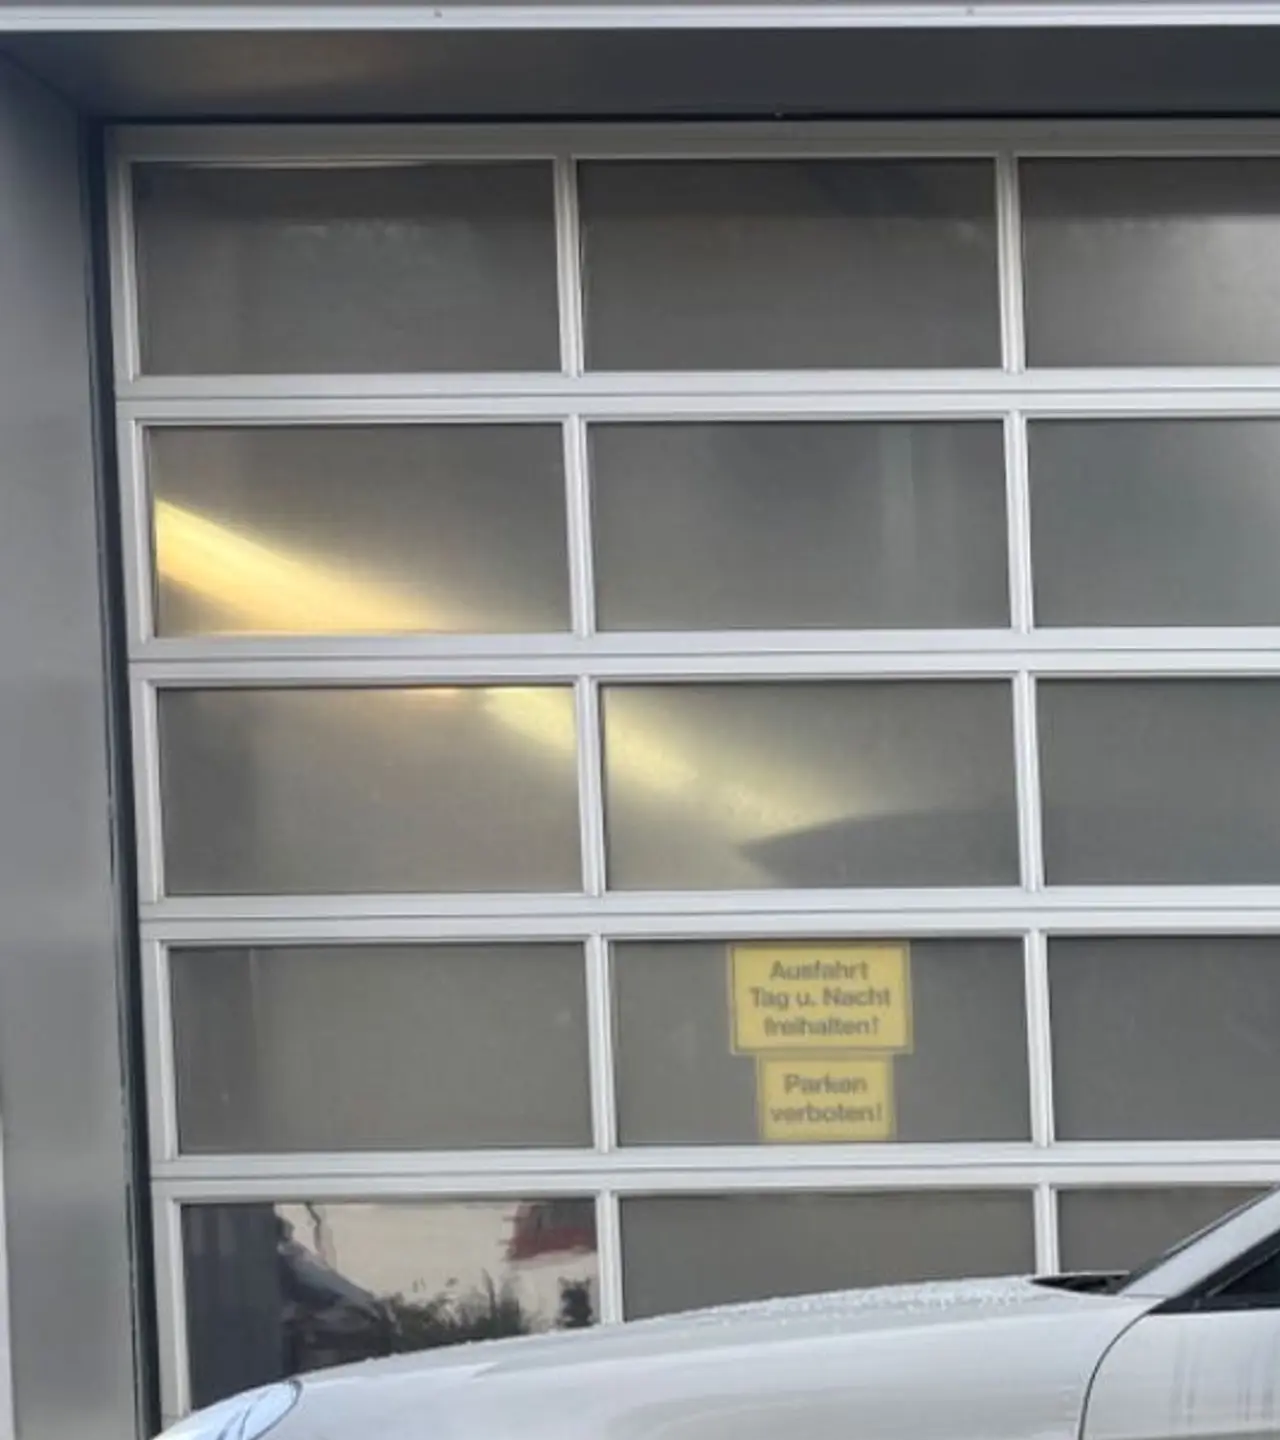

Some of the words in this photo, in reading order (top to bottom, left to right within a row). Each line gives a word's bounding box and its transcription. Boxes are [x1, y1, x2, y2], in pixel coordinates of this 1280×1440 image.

[769, 960, 870, 981] Ausfahrt
[749, 986, 789, 1010] Tag
[797, 992, 817, 1007] u.
[823, 987, 891, 1007] Nacht
[764, 1016, 880, 1037] freihalten!
[783, 1072, 868, 1095] Parken
[770, 1103, 883, 1123] verboten!
